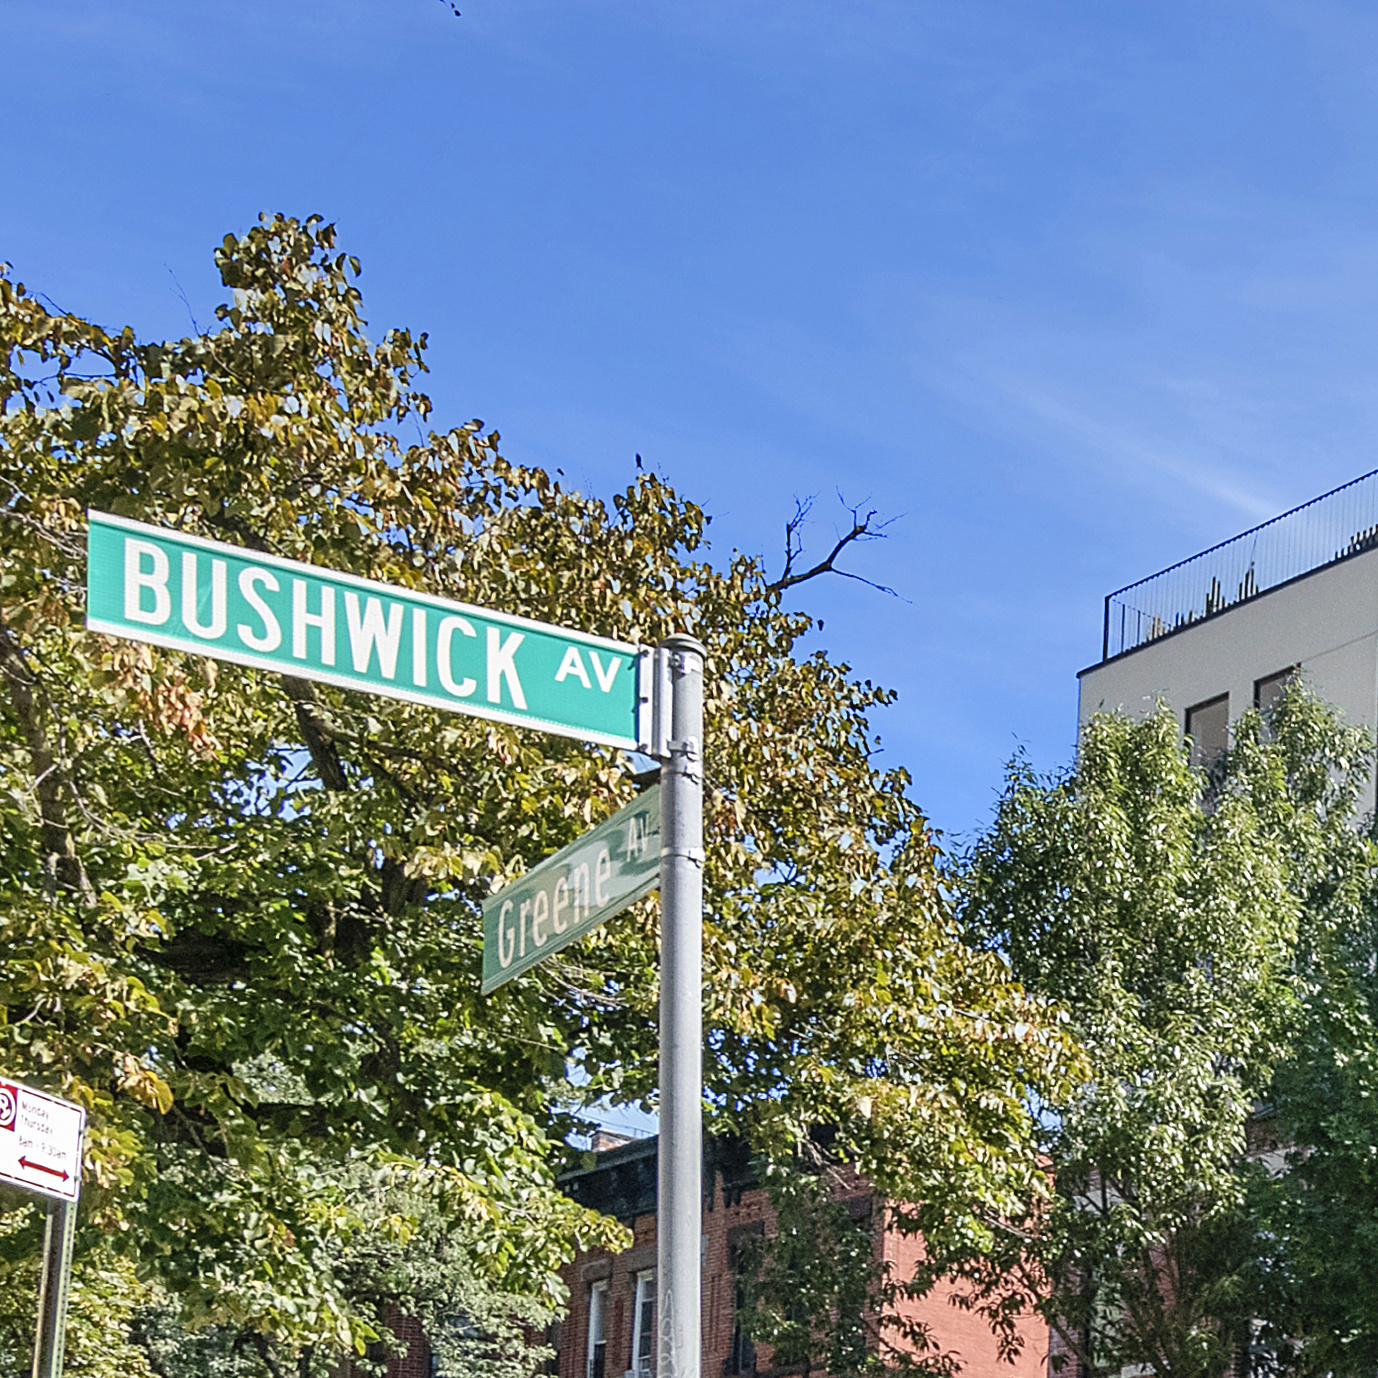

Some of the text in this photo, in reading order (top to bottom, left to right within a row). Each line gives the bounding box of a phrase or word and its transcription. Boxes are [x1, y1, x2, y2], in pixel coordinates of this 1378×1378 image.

[123, 536, 622, 710] BUSHWICK AV
[497, 847, 611, 969] Greene
